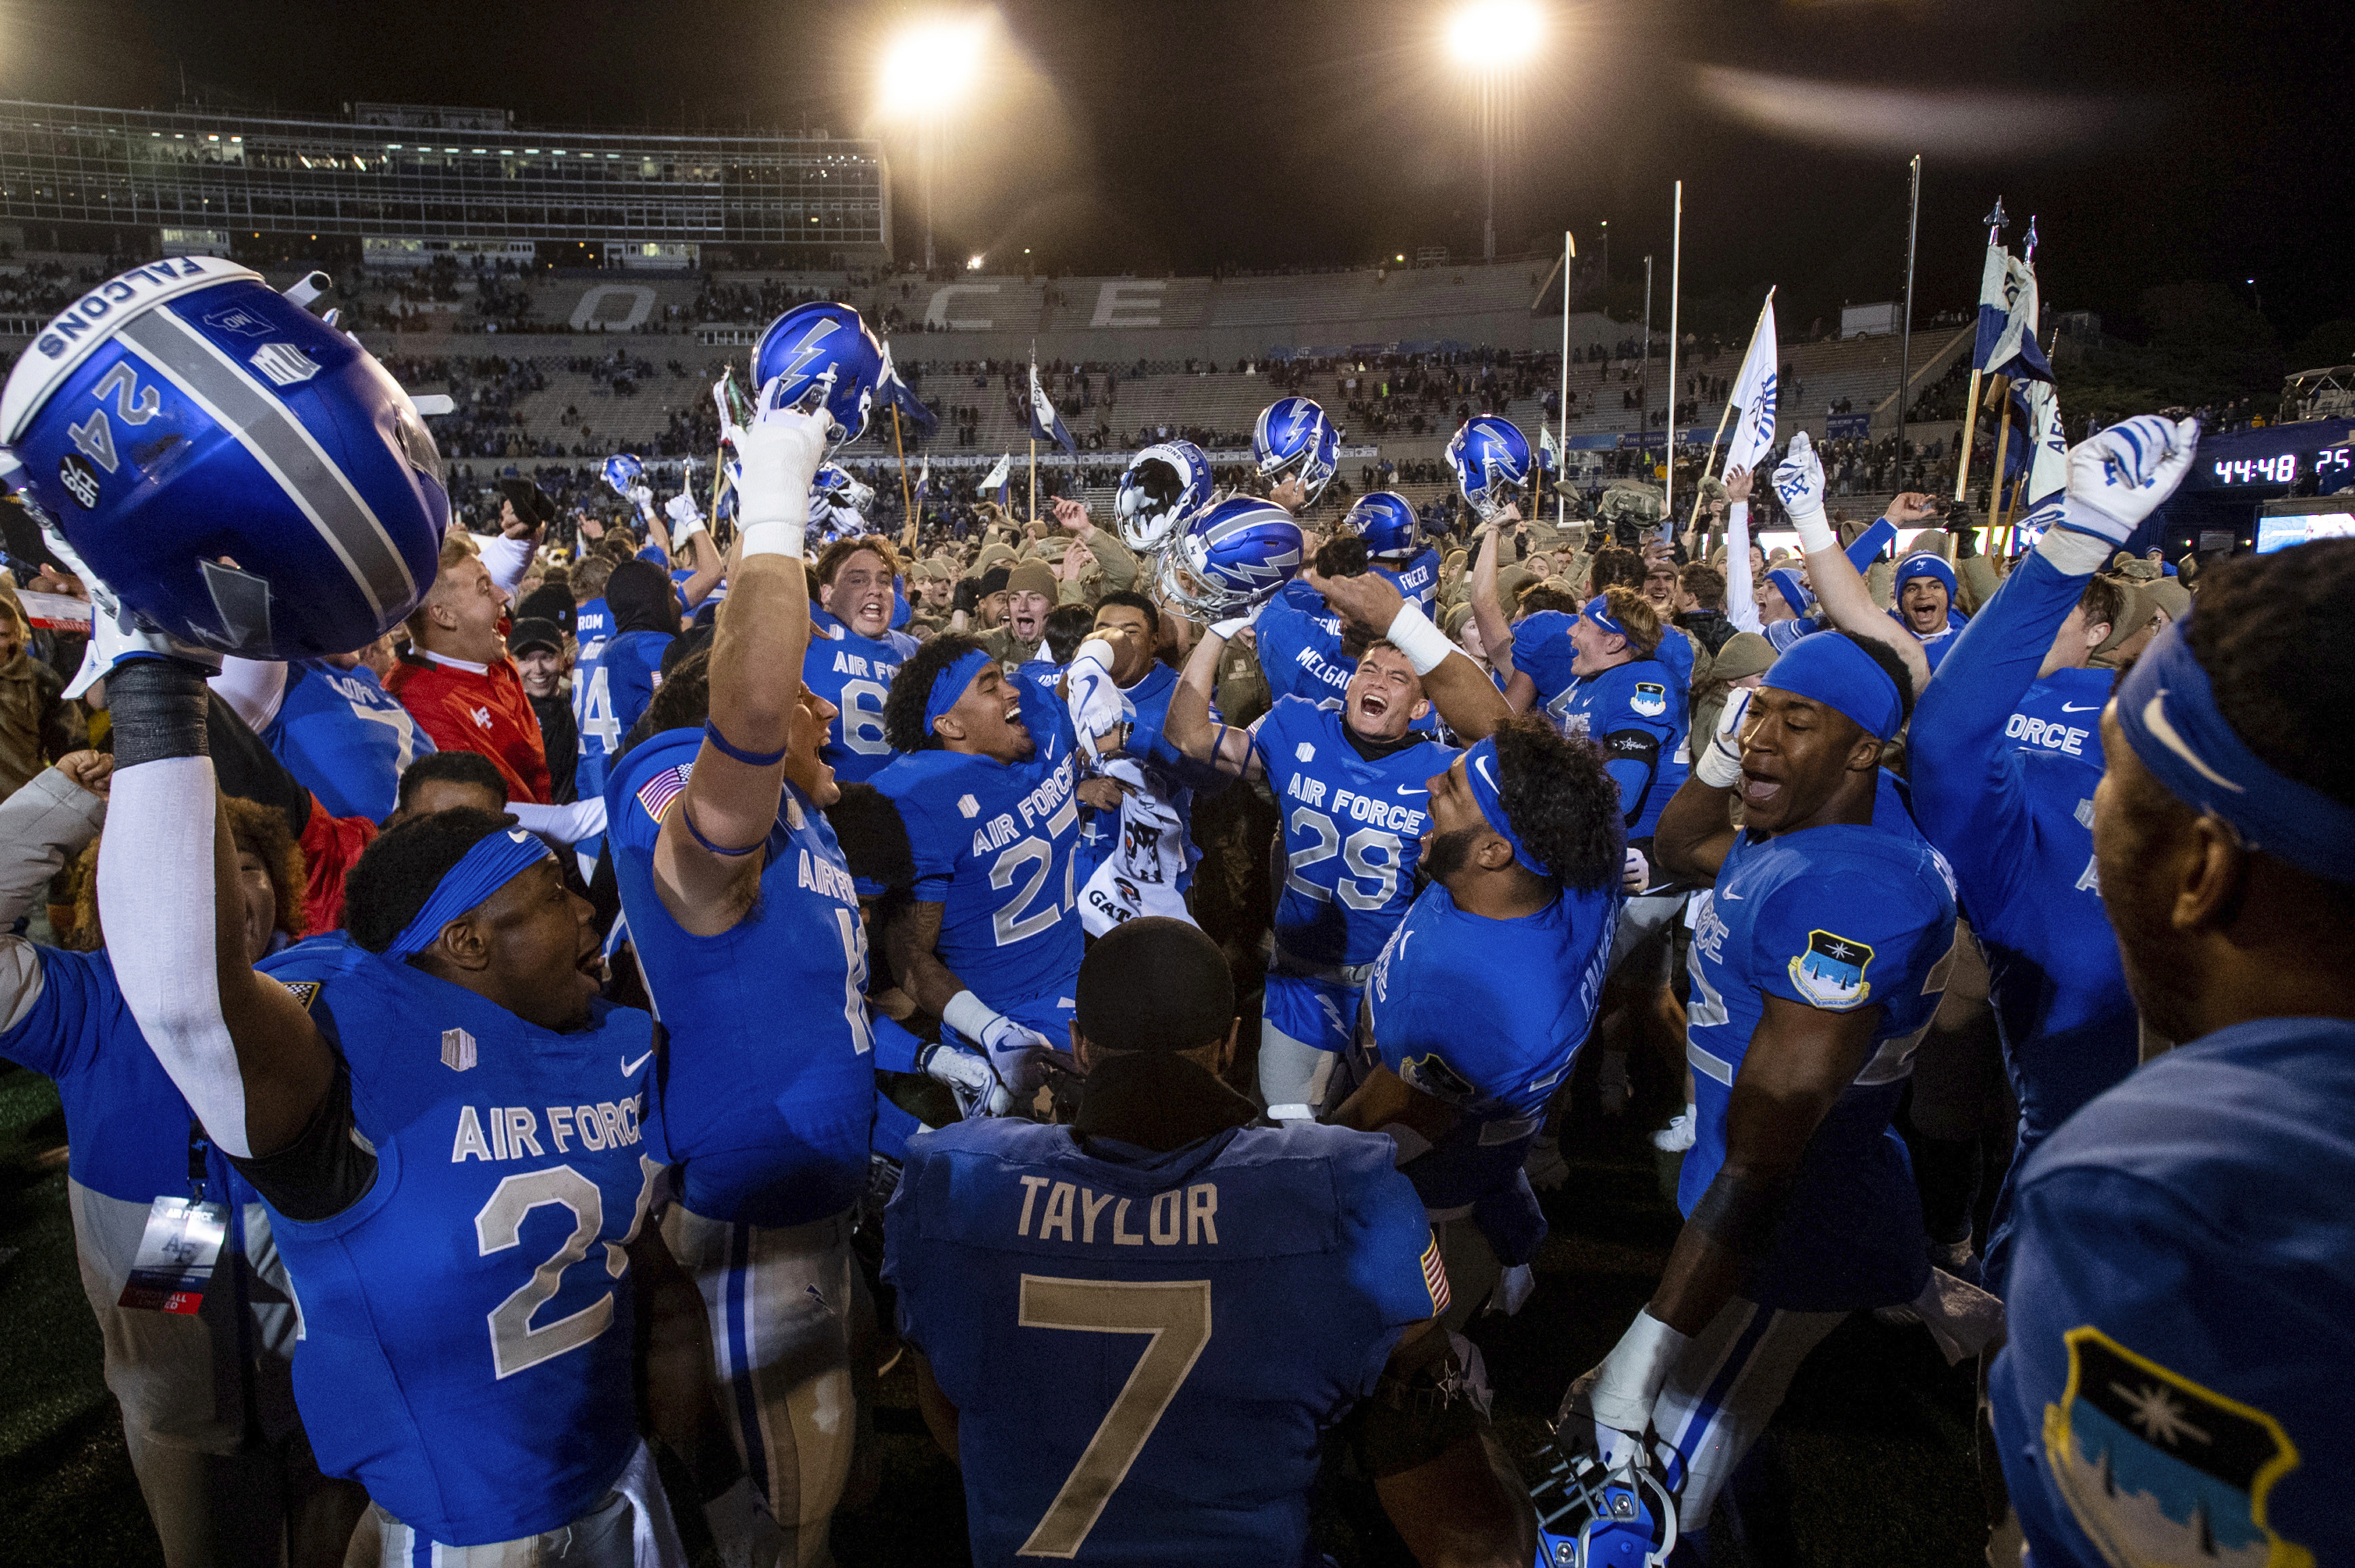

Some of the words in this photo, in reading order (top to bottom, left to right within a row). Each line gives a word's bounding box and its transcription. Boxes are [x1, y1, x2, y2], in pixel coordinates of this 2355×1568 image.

[37, 256, 206, 360] FALCONS
[68, 359, 161, 474] 24
[2215, 454, 2297, 484] 44:48
[1399, 565, 1429, 591] FREER
[832, 650, 870, 678] AIR
[2005, 713, 2090, 756] ORCE
[973, 812, 1021, 857] AIR
[1017, 751, 1074, 829] FORCE
[1287, 772, 1327, 808] AIR
[1331, 788, 1426, 836] FORCE
[798, 848, 840, 899] AIR
[1285, 806, 1404, 910] 29
[452, 1105, 545, 1163] AIR
[166, 1207, 184, 1219] AIR
[182, 1210, 214, 1221] FORCE
[1017, 1175, 1219, 1246] TAYLOR
[475, 1153, 653, 1380] 2
[1016, 1273, 1212, 1559] 7
